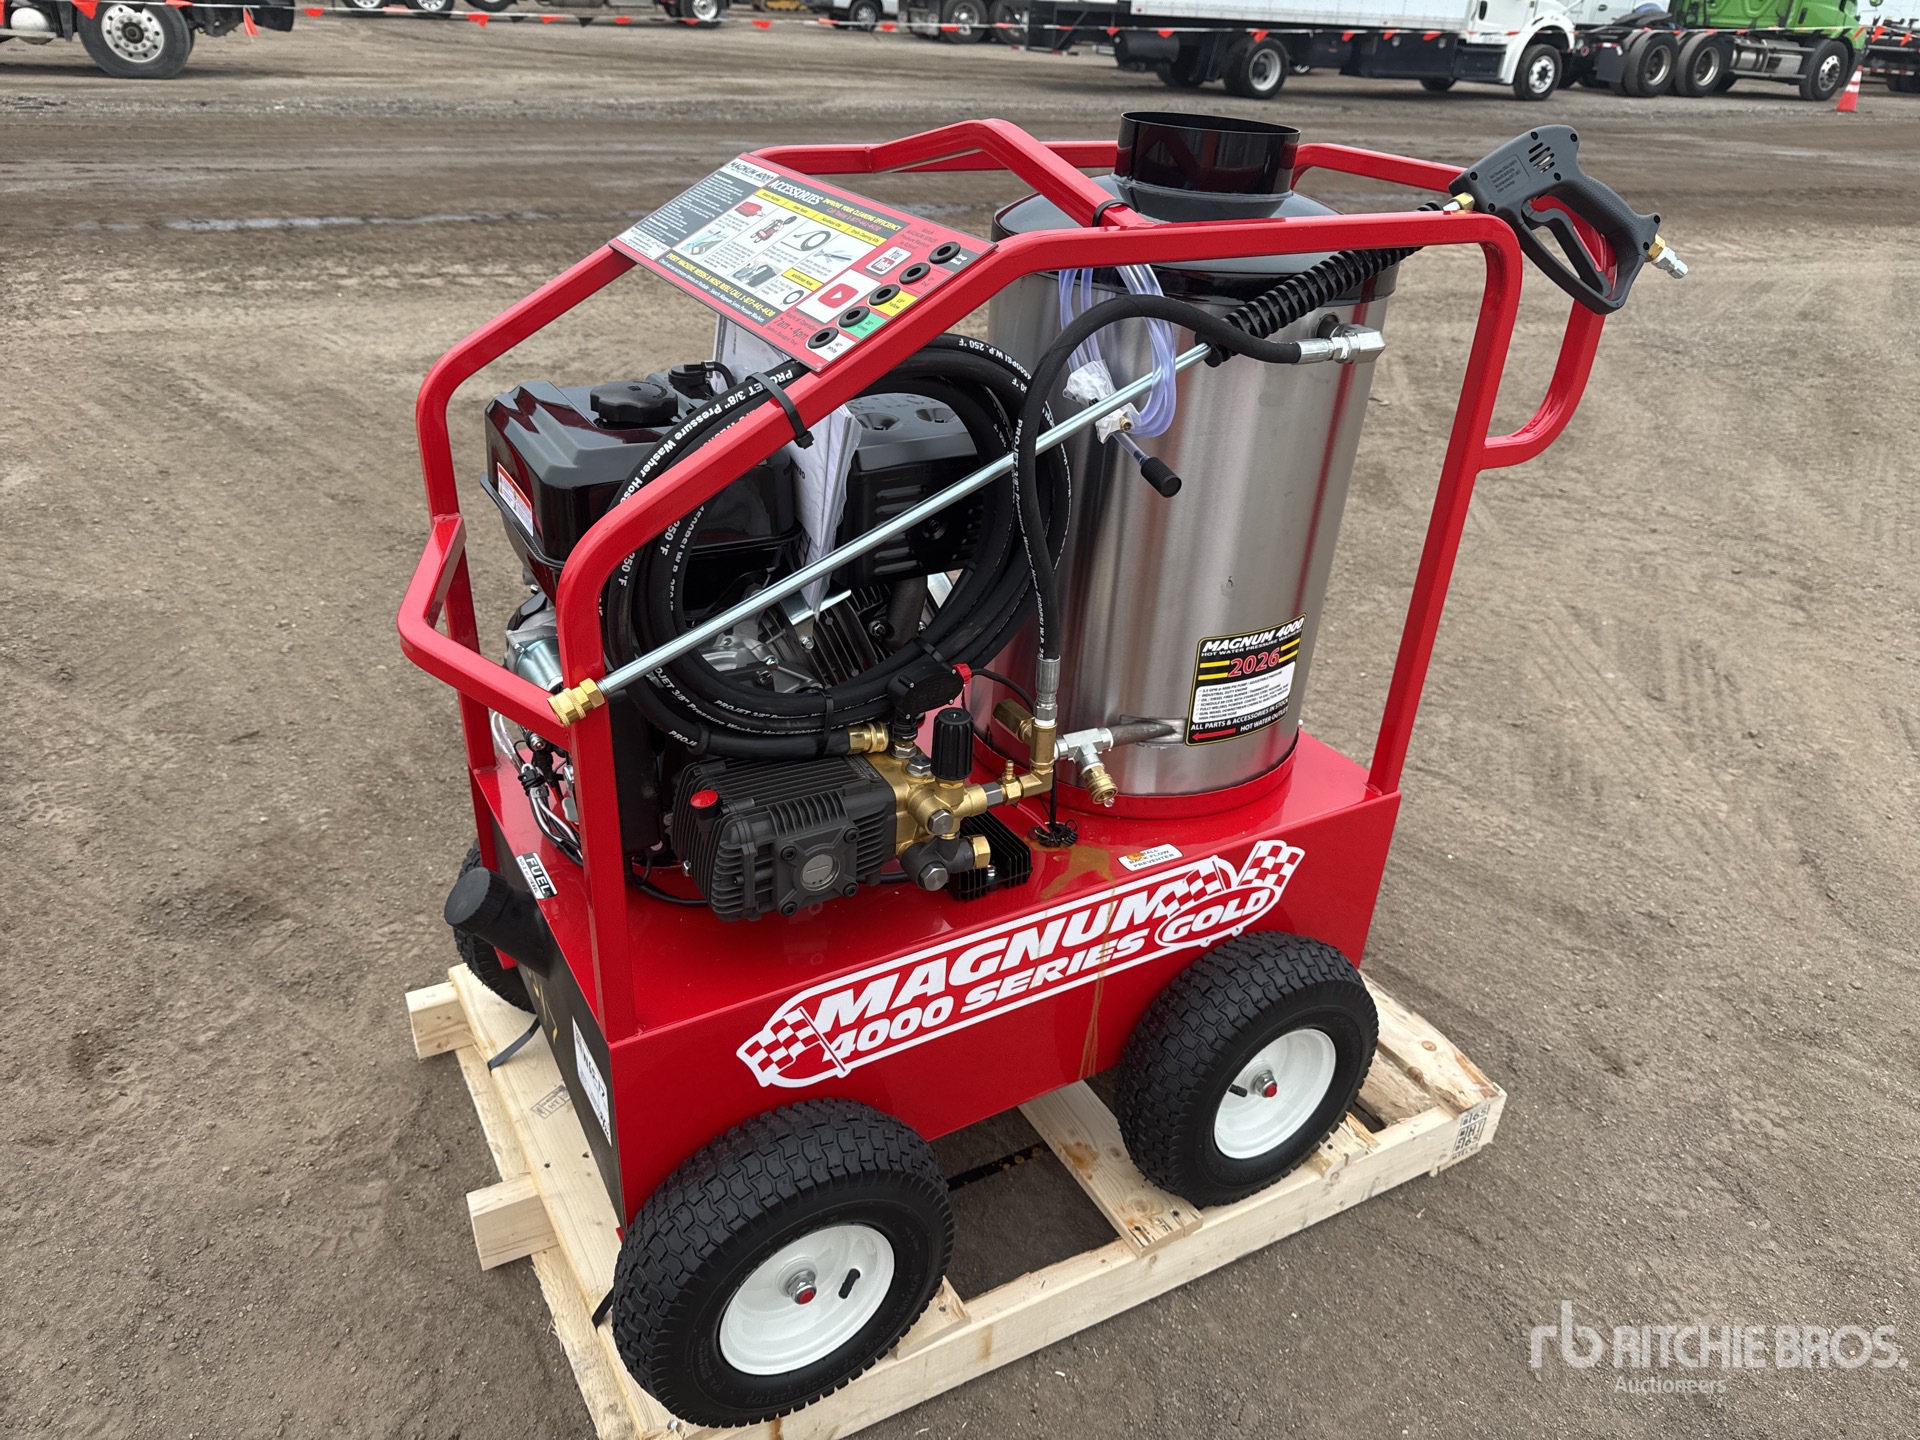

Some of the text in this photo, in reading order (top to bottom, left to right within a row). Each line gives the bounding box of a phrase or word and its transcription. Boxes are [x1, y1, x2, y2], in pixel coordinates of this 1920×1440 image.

[766, 179, 825, 205] ACCESSORIES
[839, 205, 855, 213] YOUR
[850, 209, 877, 221] CLEANING
[871, 217, 902, 231] EFFICIENCY
[665, 252, 681, 262] EVERY
[676, 259, 697, 271] MACHINE
[691, 268, 709, 278] NEEDS
[707, 276, 722, 286] HOSE
[728, 289, 743, 298] CALL
[872, 259, 893, 270] Tube
[773, 317, 811, 341] 7am 4pm
[797, 319, 819, 332] Operation
[968, 339, 985, 352] 250
[749, 369, 793, 395] PROET
[724, 389, 746, 407] 3/8"
[674, 404, 723, 440] Pressure
[1013, 418, 1024, 470] PROJET
[640, 440, 677, 478] Washer
[1013, 492, 1027, 534] Pressure
[1022, 536, 1036, 568] Washer
[1202, 617, 1304, 652] MAGNUM 4000
[1219, 648, 1244, 656] WATER
[1228, 647, 1280, 677] 2026
[654, 666, 675, 690] OJET
[671, 690, 690, 703] 3/8"
[686, 703, 726, 726] Pressure
[713, 700, 752, 716] PROJET
[1205, 720, 1226, 729] PARTS
[1232, 708, 1269, 724] ACCESSORIES
[1240, 723, 1253, 732] HOT
[1253, 716, 1271, 729] WATER
[1133, 853, 1175, 868] PREVENTER
[526, 857, 551, 894] FUEL
[527, 876, 539, 893] DIESEL
[1164, 888, 1270, 940] GOLD
[807, 879, 1187, 1032] MAGNUM
[822, 930, 1150, 1062] 4000 SERIES
